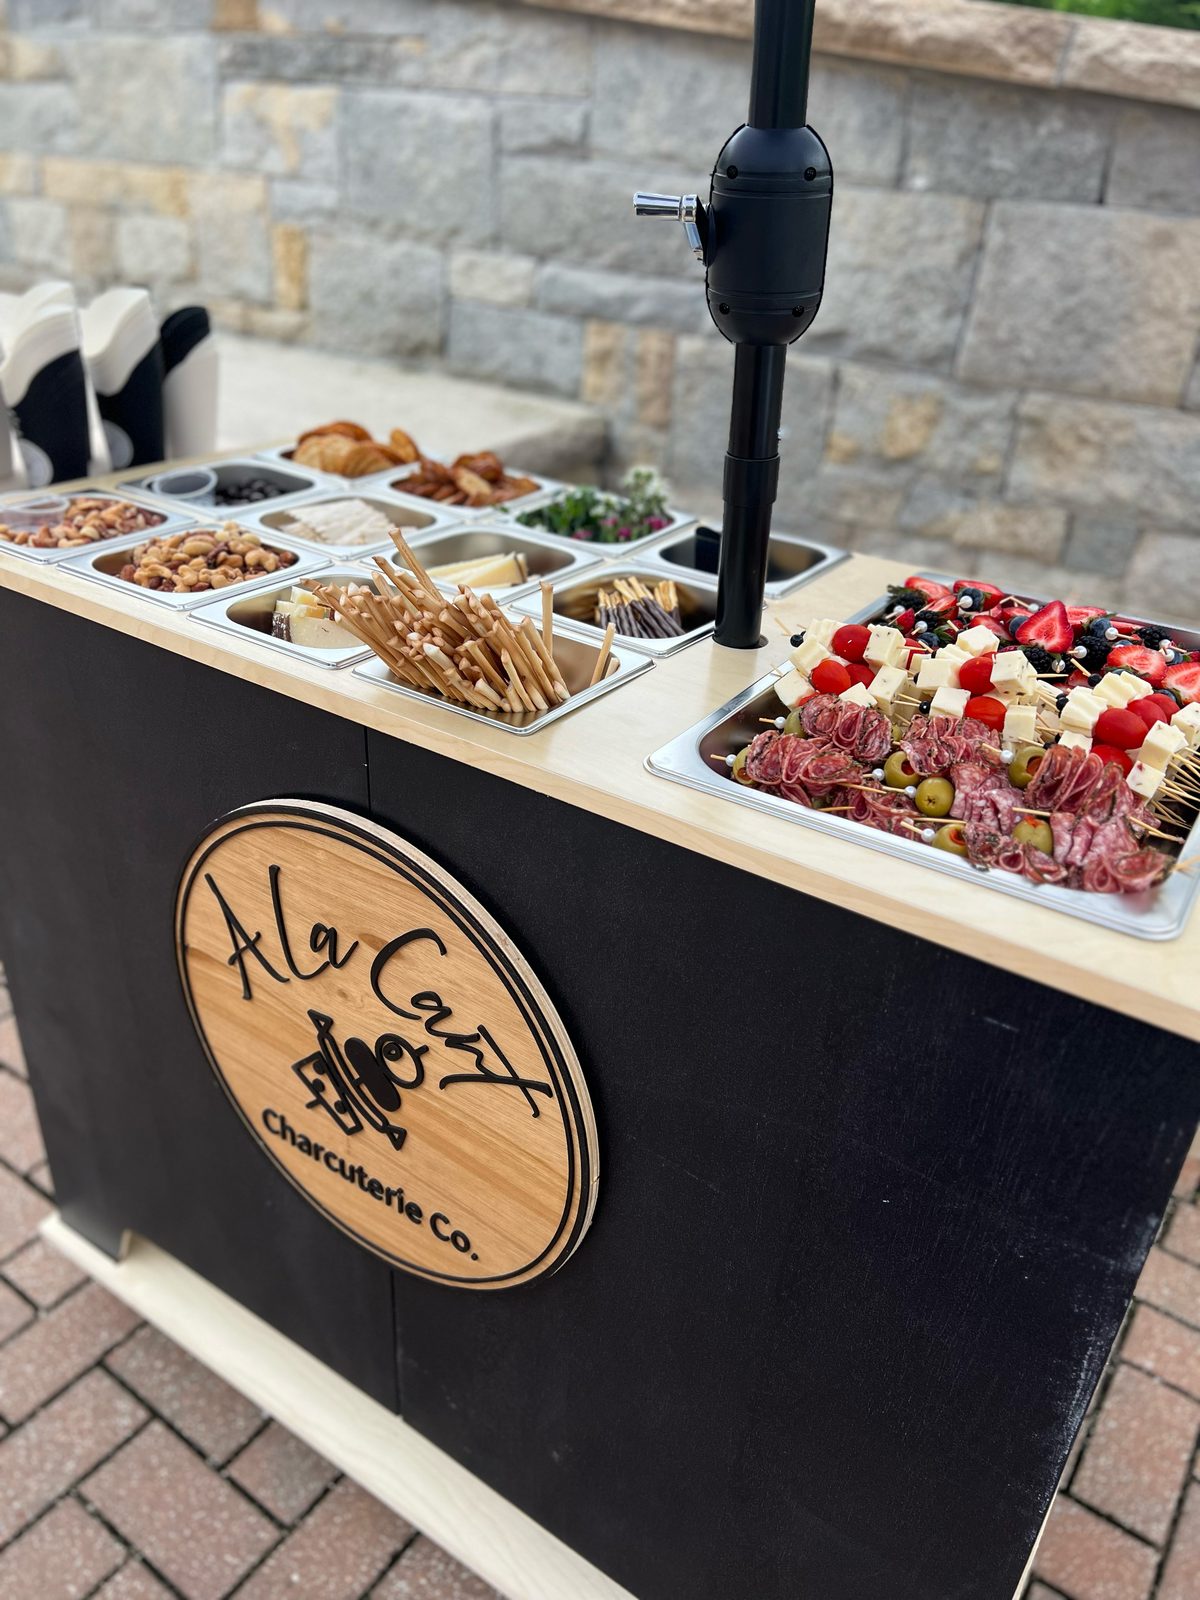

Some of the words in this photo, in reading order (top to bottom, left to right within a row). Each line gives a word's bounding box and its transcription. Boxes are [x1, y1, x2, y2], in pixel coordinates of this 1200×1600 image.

[370, 927, 554, 1119] Cart
[262, 1109, 424, 1225] Charcuterie
[430, 1212, 479, 1261] Co.
